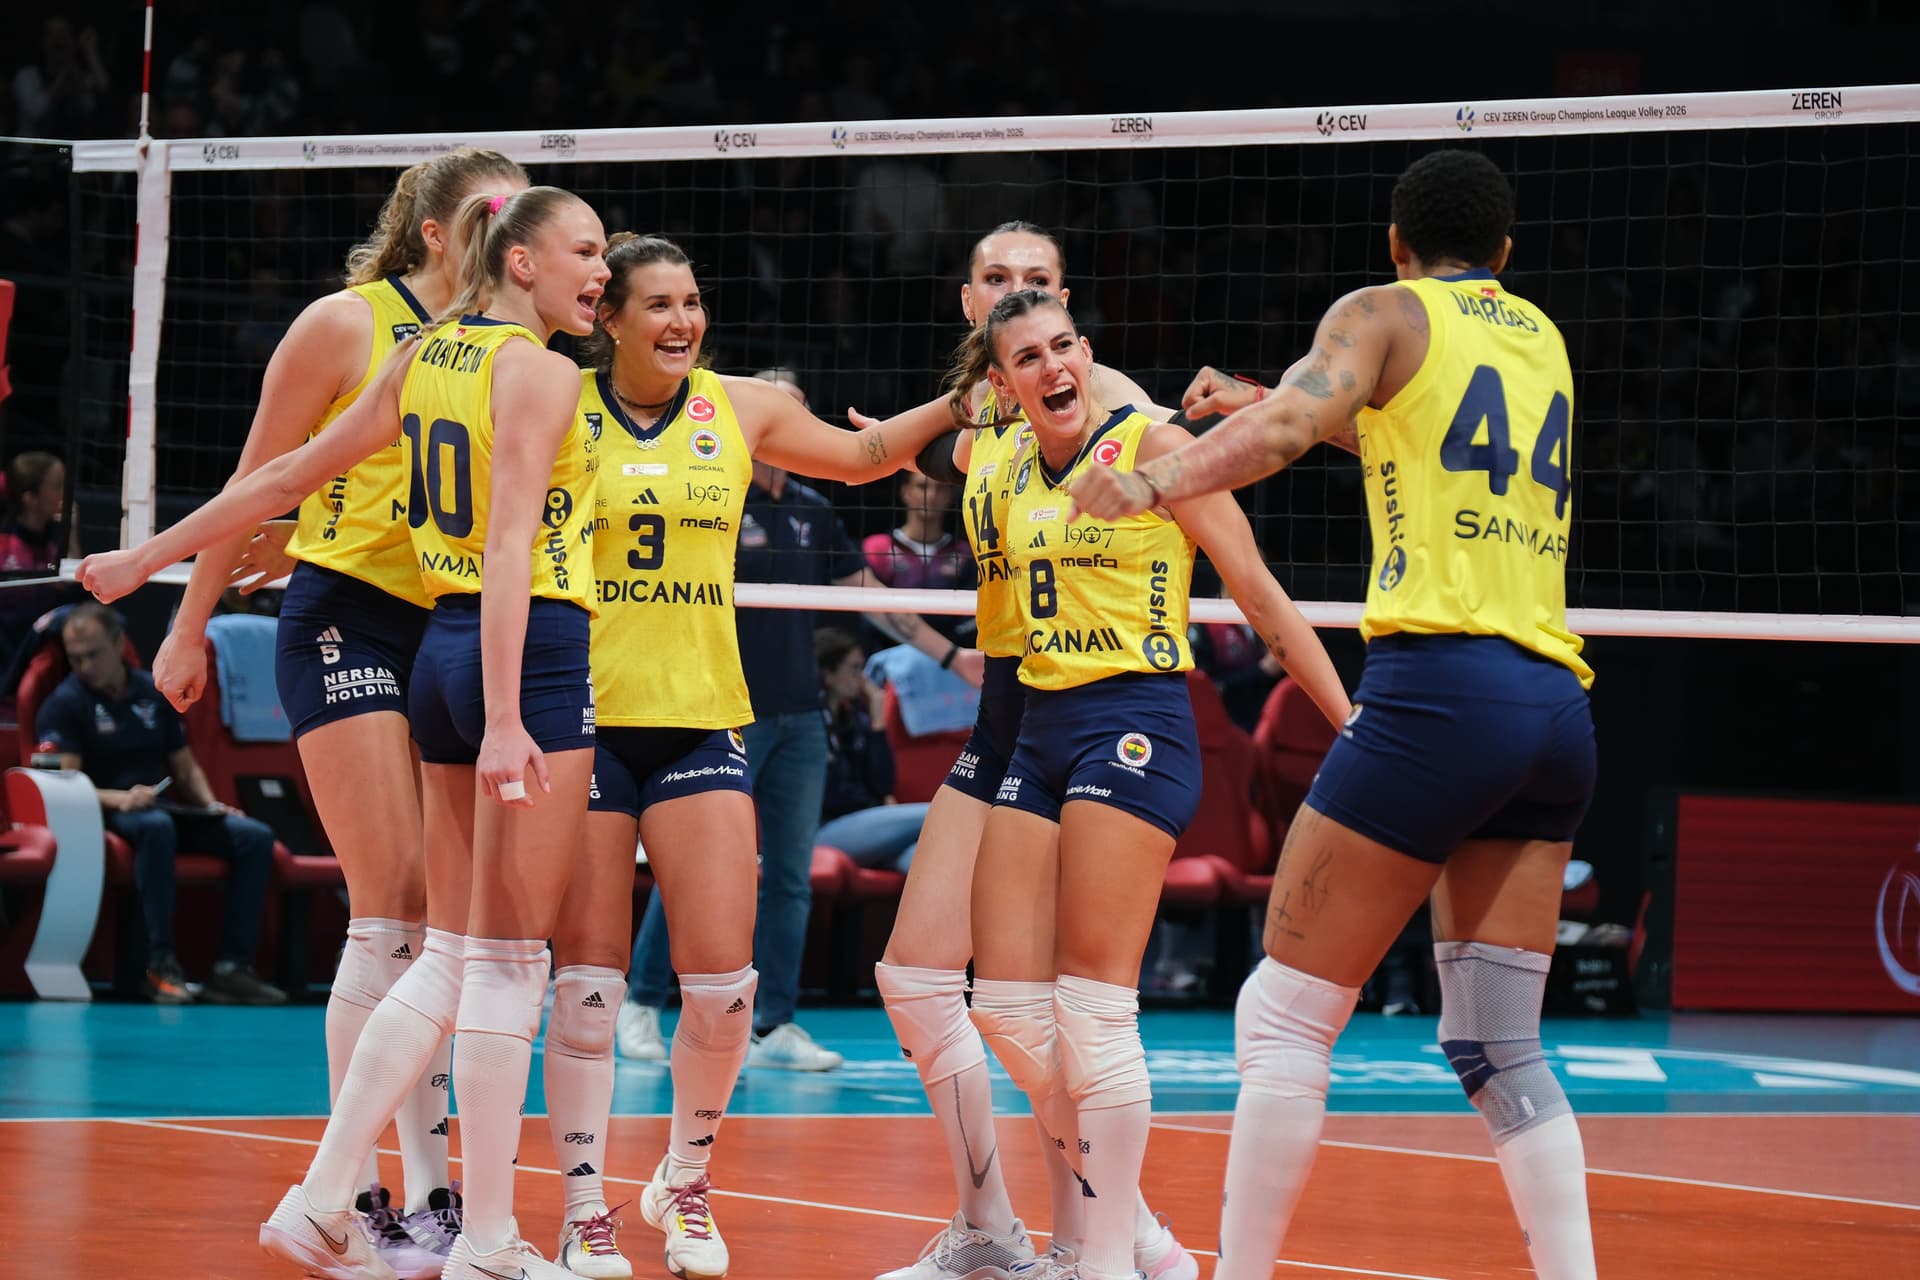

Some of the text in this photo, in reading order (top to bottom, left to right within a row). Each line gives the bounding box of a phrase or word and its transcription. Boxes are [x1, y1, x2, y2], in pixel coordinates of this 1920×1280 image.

[1791, 91, 1842, 110] ZEREN
[1338, 115, 1367, 131] CEV
[1483, 105, 1687, 123] CEV ZEREN Group Champions League Volley 2026
[1814, 110, 1843, 120] GROUP
[1111, 116, 1153, 133] ZEREN
[732, 132, 757, 148] CEV
[1450, 290, 1539, 333] VARGAS
[1440, 364, 1571, 521] 44
[402, 413, 474, 539] 10
[680, 516, 729, 532] mefa
[968, 491, 1000, 553] 14
[627, 513, 666, 571] 3
[1060, 553, 1118, 569] mefa
[1028, 558, 1058, 619] 8
[320, 644, 341, 665] 5
[323, 666, 395, 687] NERSAN
[391, 953, 413, 961] adidas
[581, 1000, 606, 1009] adidas
